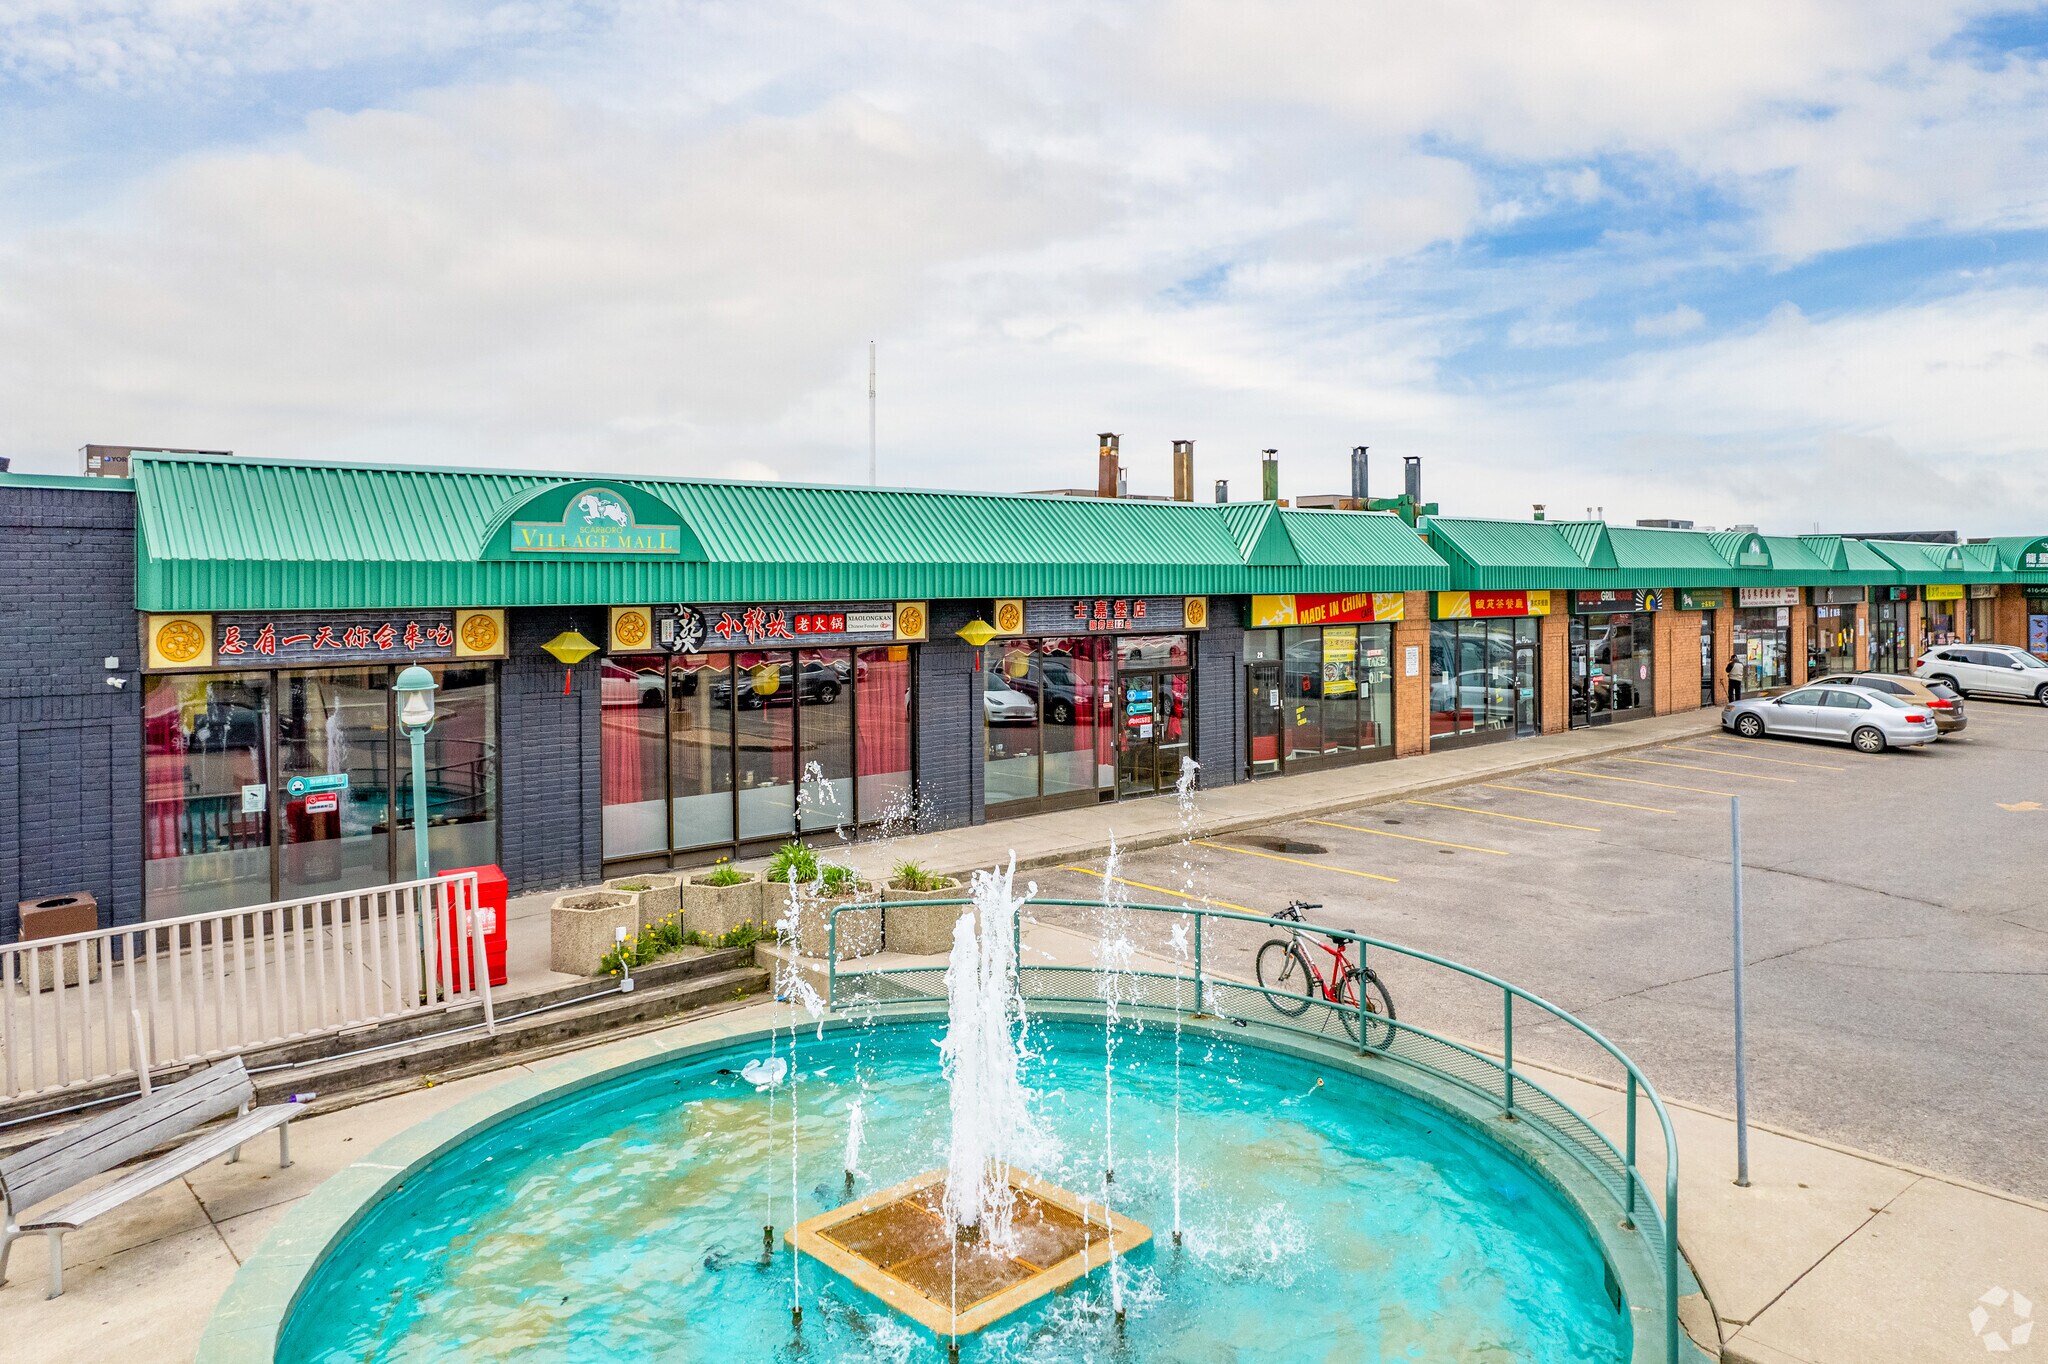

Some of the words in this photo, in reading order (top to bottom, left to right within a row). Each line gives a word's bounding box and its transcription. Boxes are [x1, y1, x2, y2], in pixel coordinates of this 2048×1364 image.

[521, 528, 610, 548] VILLAGE
[618, 532, 672, 549] MALL
[579, 526, 624, 534] SCARBORO
[1600, 590, 1616, 601] GRILL
[1073, 599, 1147, 619] 士嘉堡店
[1300, 604, 1327, 625] MADE
[1329, 600, 1340, 617] IN
[1341, 592, 1368, 613] CHINA
[797, 615, 844, 632] 老火锅
[219, 620, 453, 656] 总有一天你会来吃
